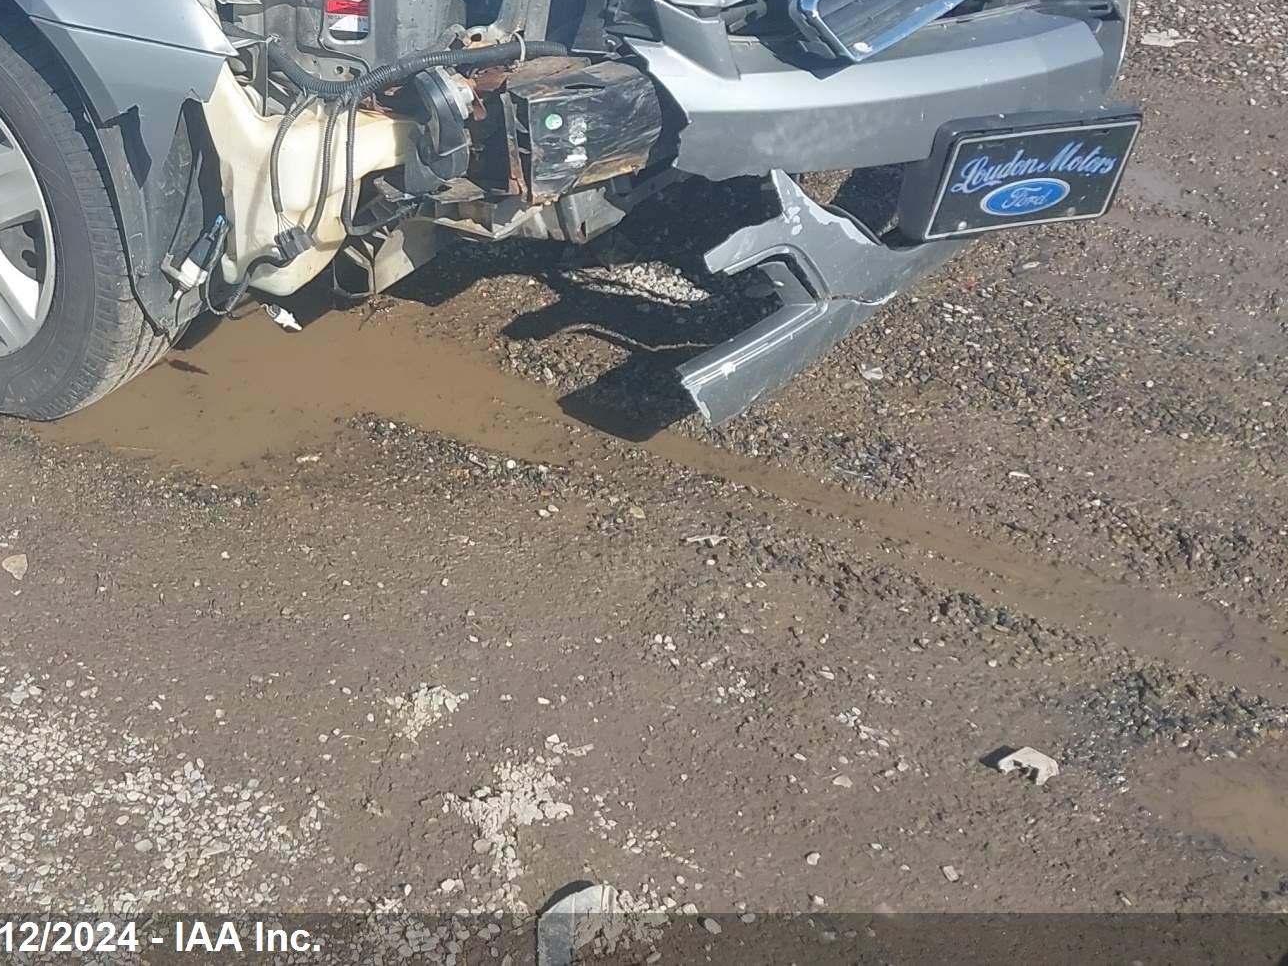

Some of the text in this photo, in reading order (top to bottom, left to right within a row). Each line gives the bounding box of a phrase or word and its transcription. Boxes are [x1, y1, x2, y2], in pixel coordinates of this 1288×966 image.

[951, 140, 1117, 194] Loudon Motors
[1000, 185, 1052, 210] Ford
